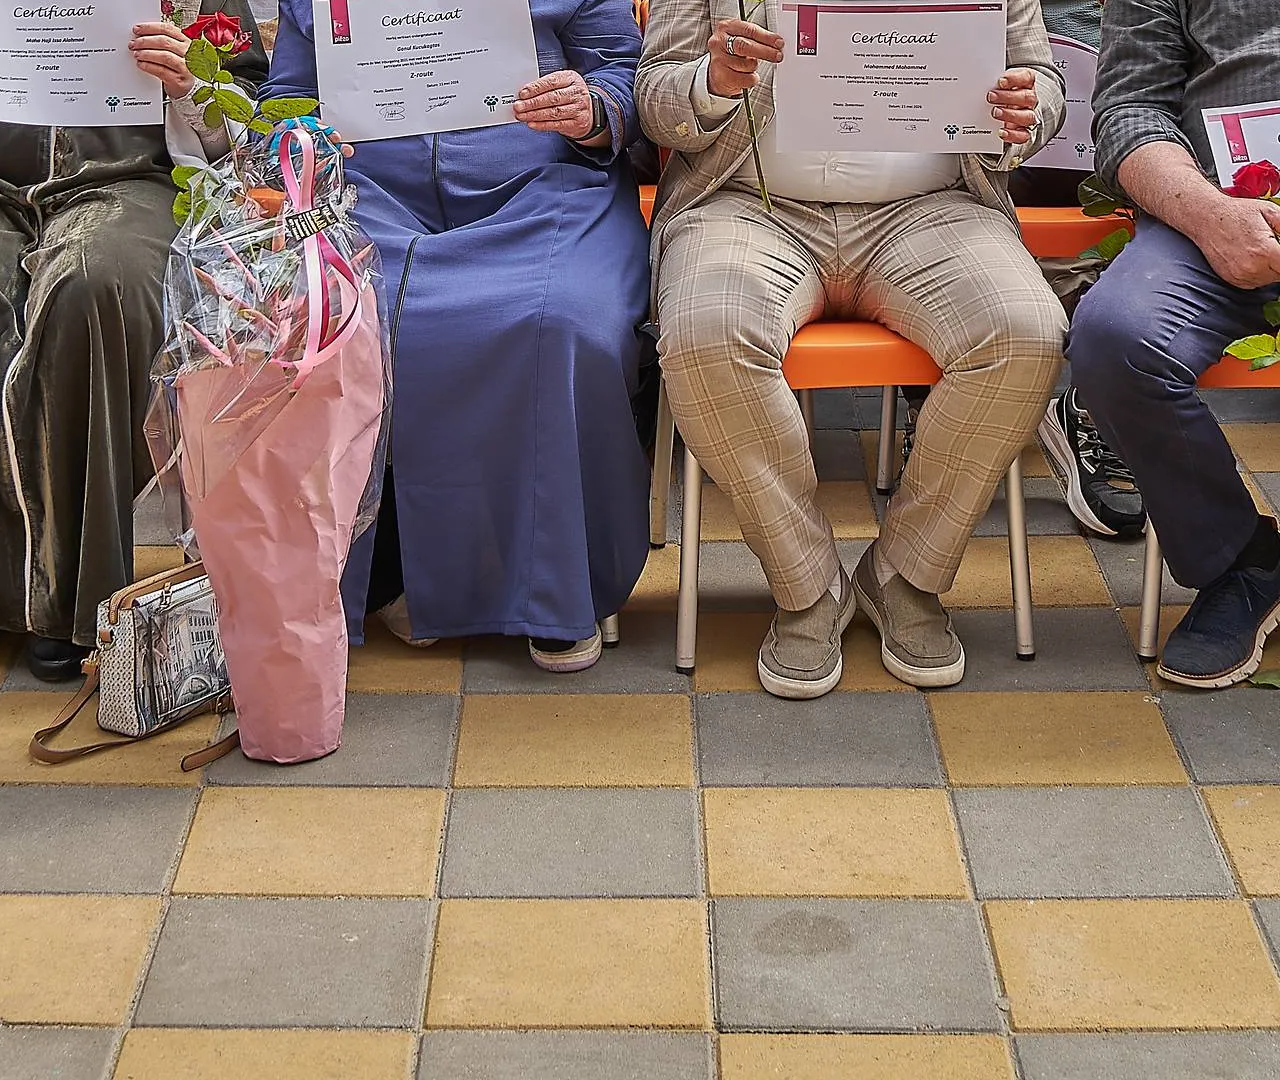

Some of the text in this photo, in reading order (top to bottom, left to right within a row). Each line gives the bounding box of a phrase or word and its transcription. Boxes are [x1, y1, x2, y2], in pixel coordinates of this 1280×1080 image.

[13, 4, 95, 20] Certificaat
[381, 7, 463, 27] Certificaat
[851, 31, 938, 46] Certificaat
[409, 70, 434, 79] Z-route
[872, 90, 898, 98] Z-route
